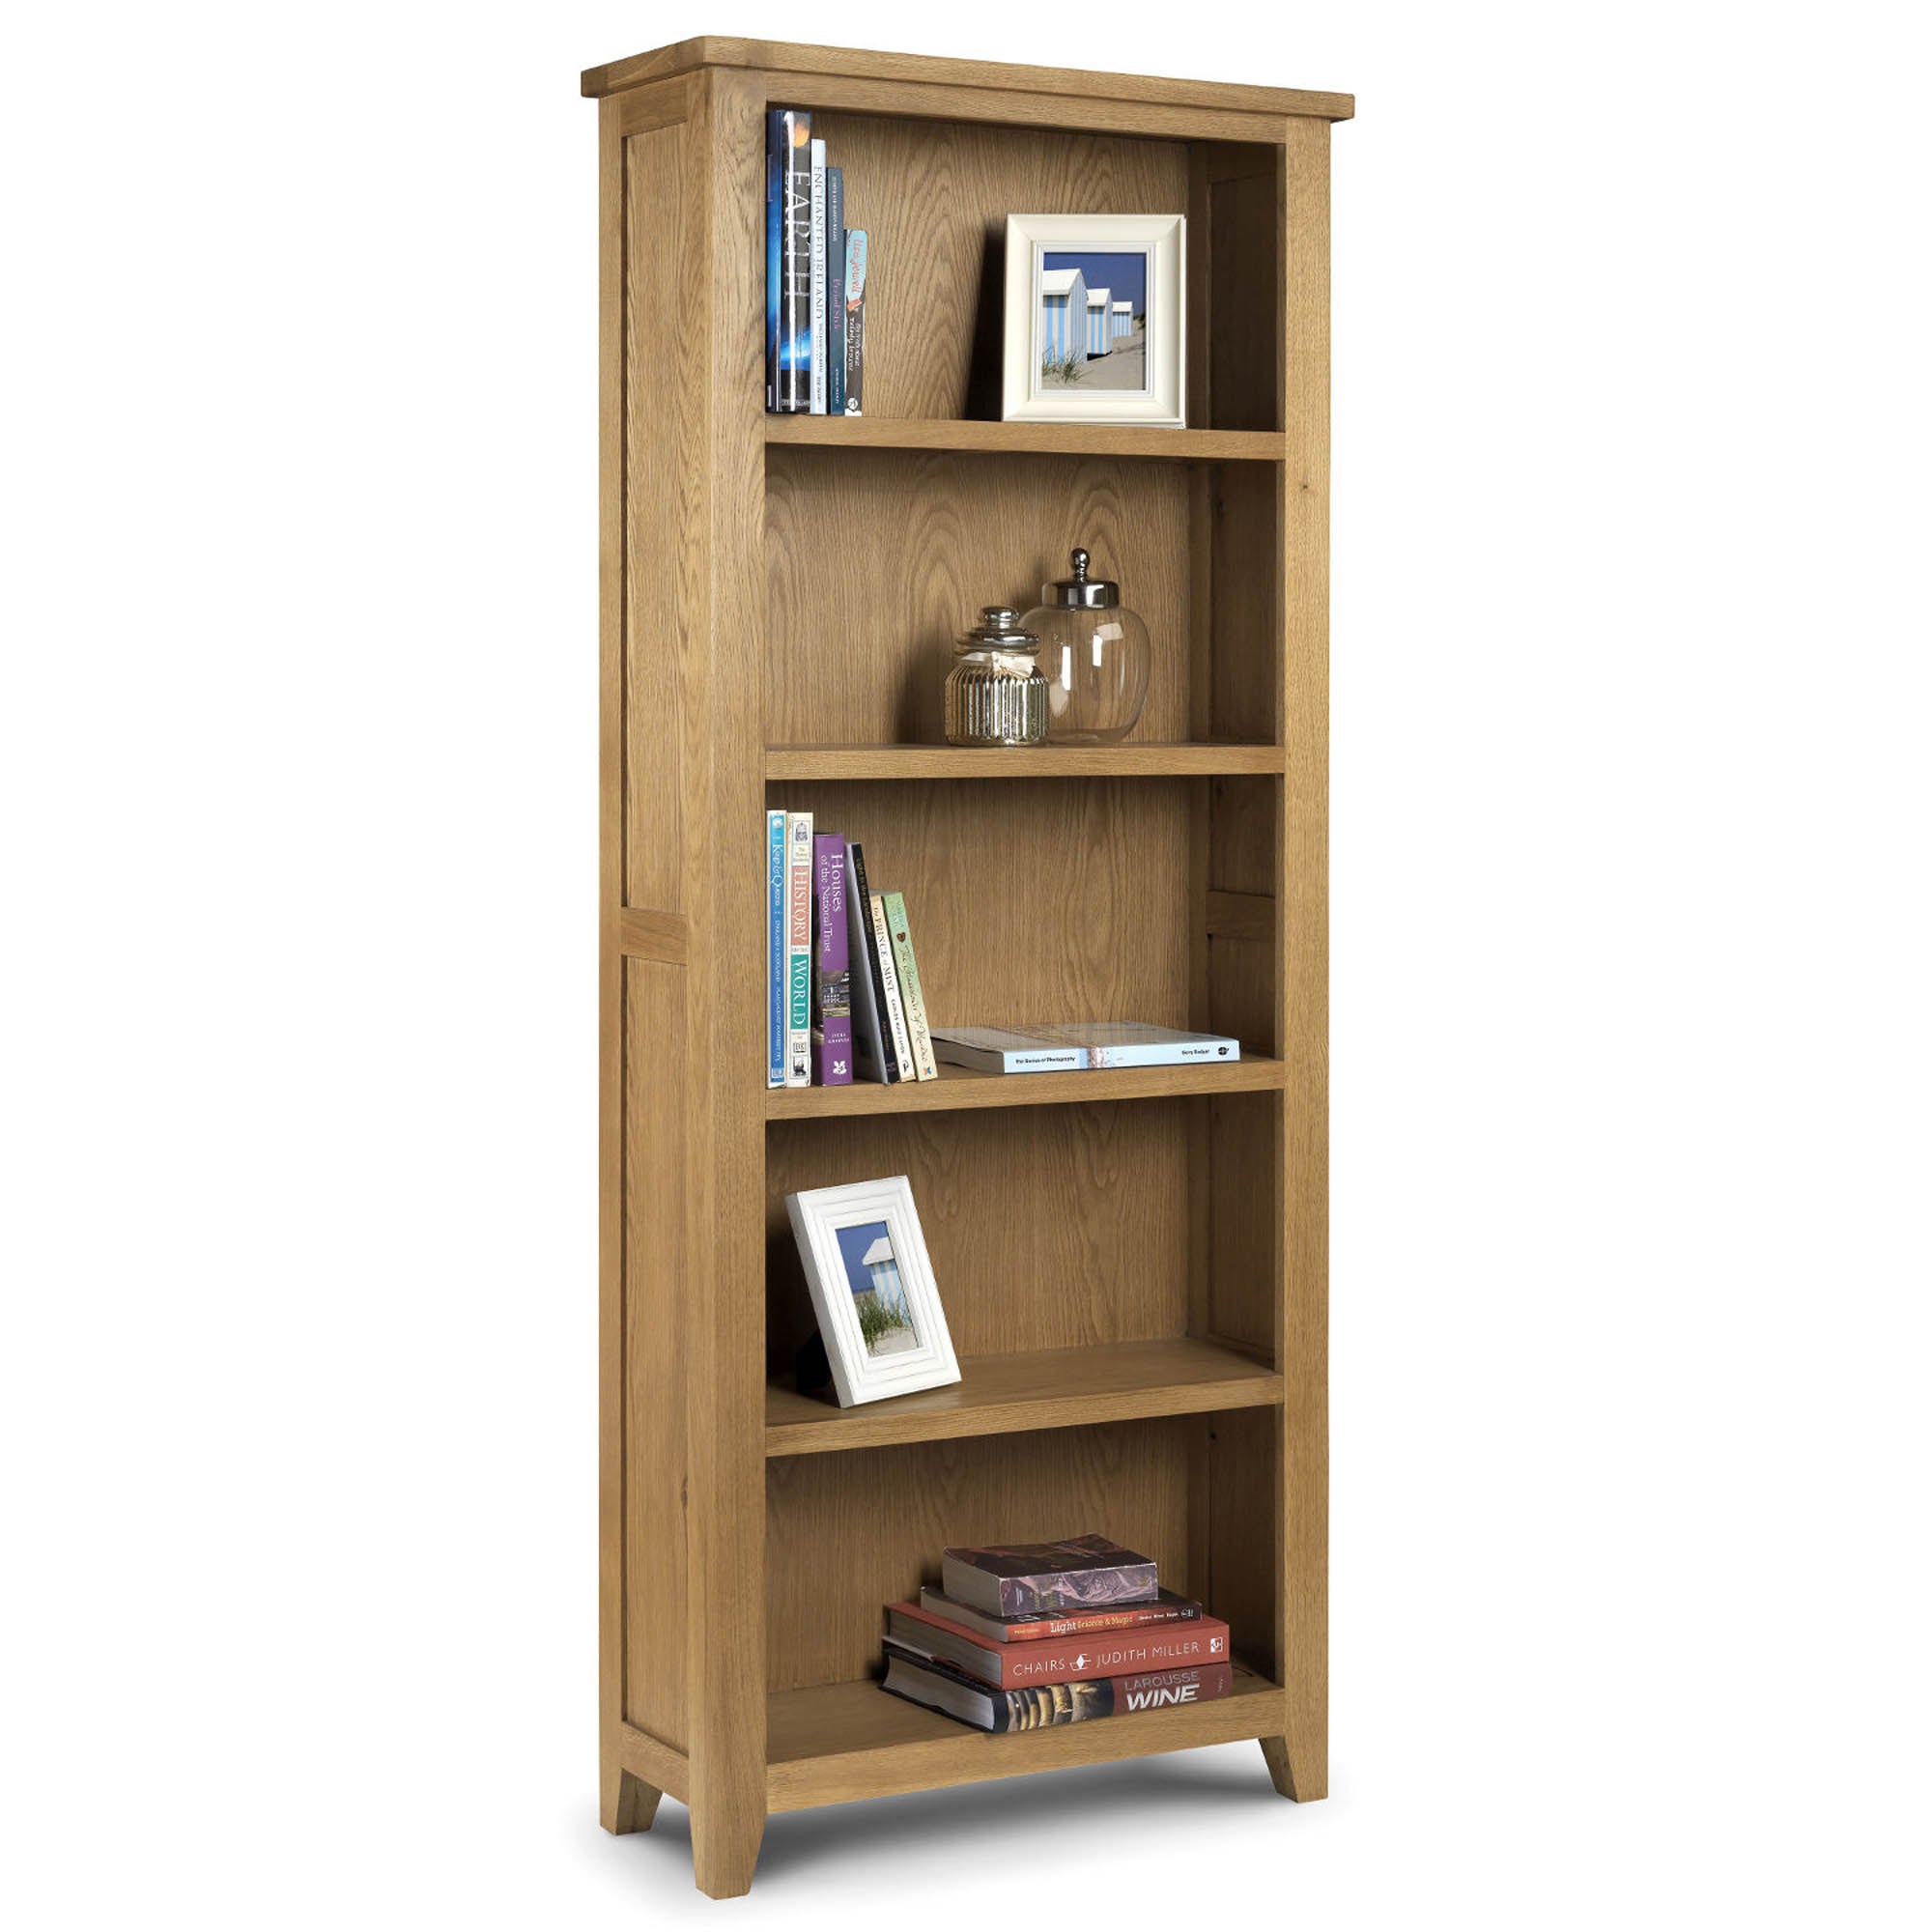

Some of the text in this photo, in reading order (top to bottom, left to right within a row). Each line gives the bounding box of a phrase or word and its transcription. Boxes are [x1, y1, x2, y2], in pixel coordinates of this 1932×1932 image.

[784, 171, 811, 299] EARTH
[813, 166, 823, 254] ENCHANTED
[793, 870, 809, 940] HISTORY
[820, 855, 833, 952] of the National Trust
[832, 854, 843, 912] Houses
[874, 918, 889, 957] PRINCE
[884, 966, 895, 993] MIST
[793, 959, 808, 1024] WORLD
[1012, 1641, 1199, 1676] CHAIRS JUDITH MILLER
[1050, 1622, 1076, 1634] Light
[1124, 1671, 1201, 1690] LAROUSSE
[1126, 1683, 1201, 1712] WINE
